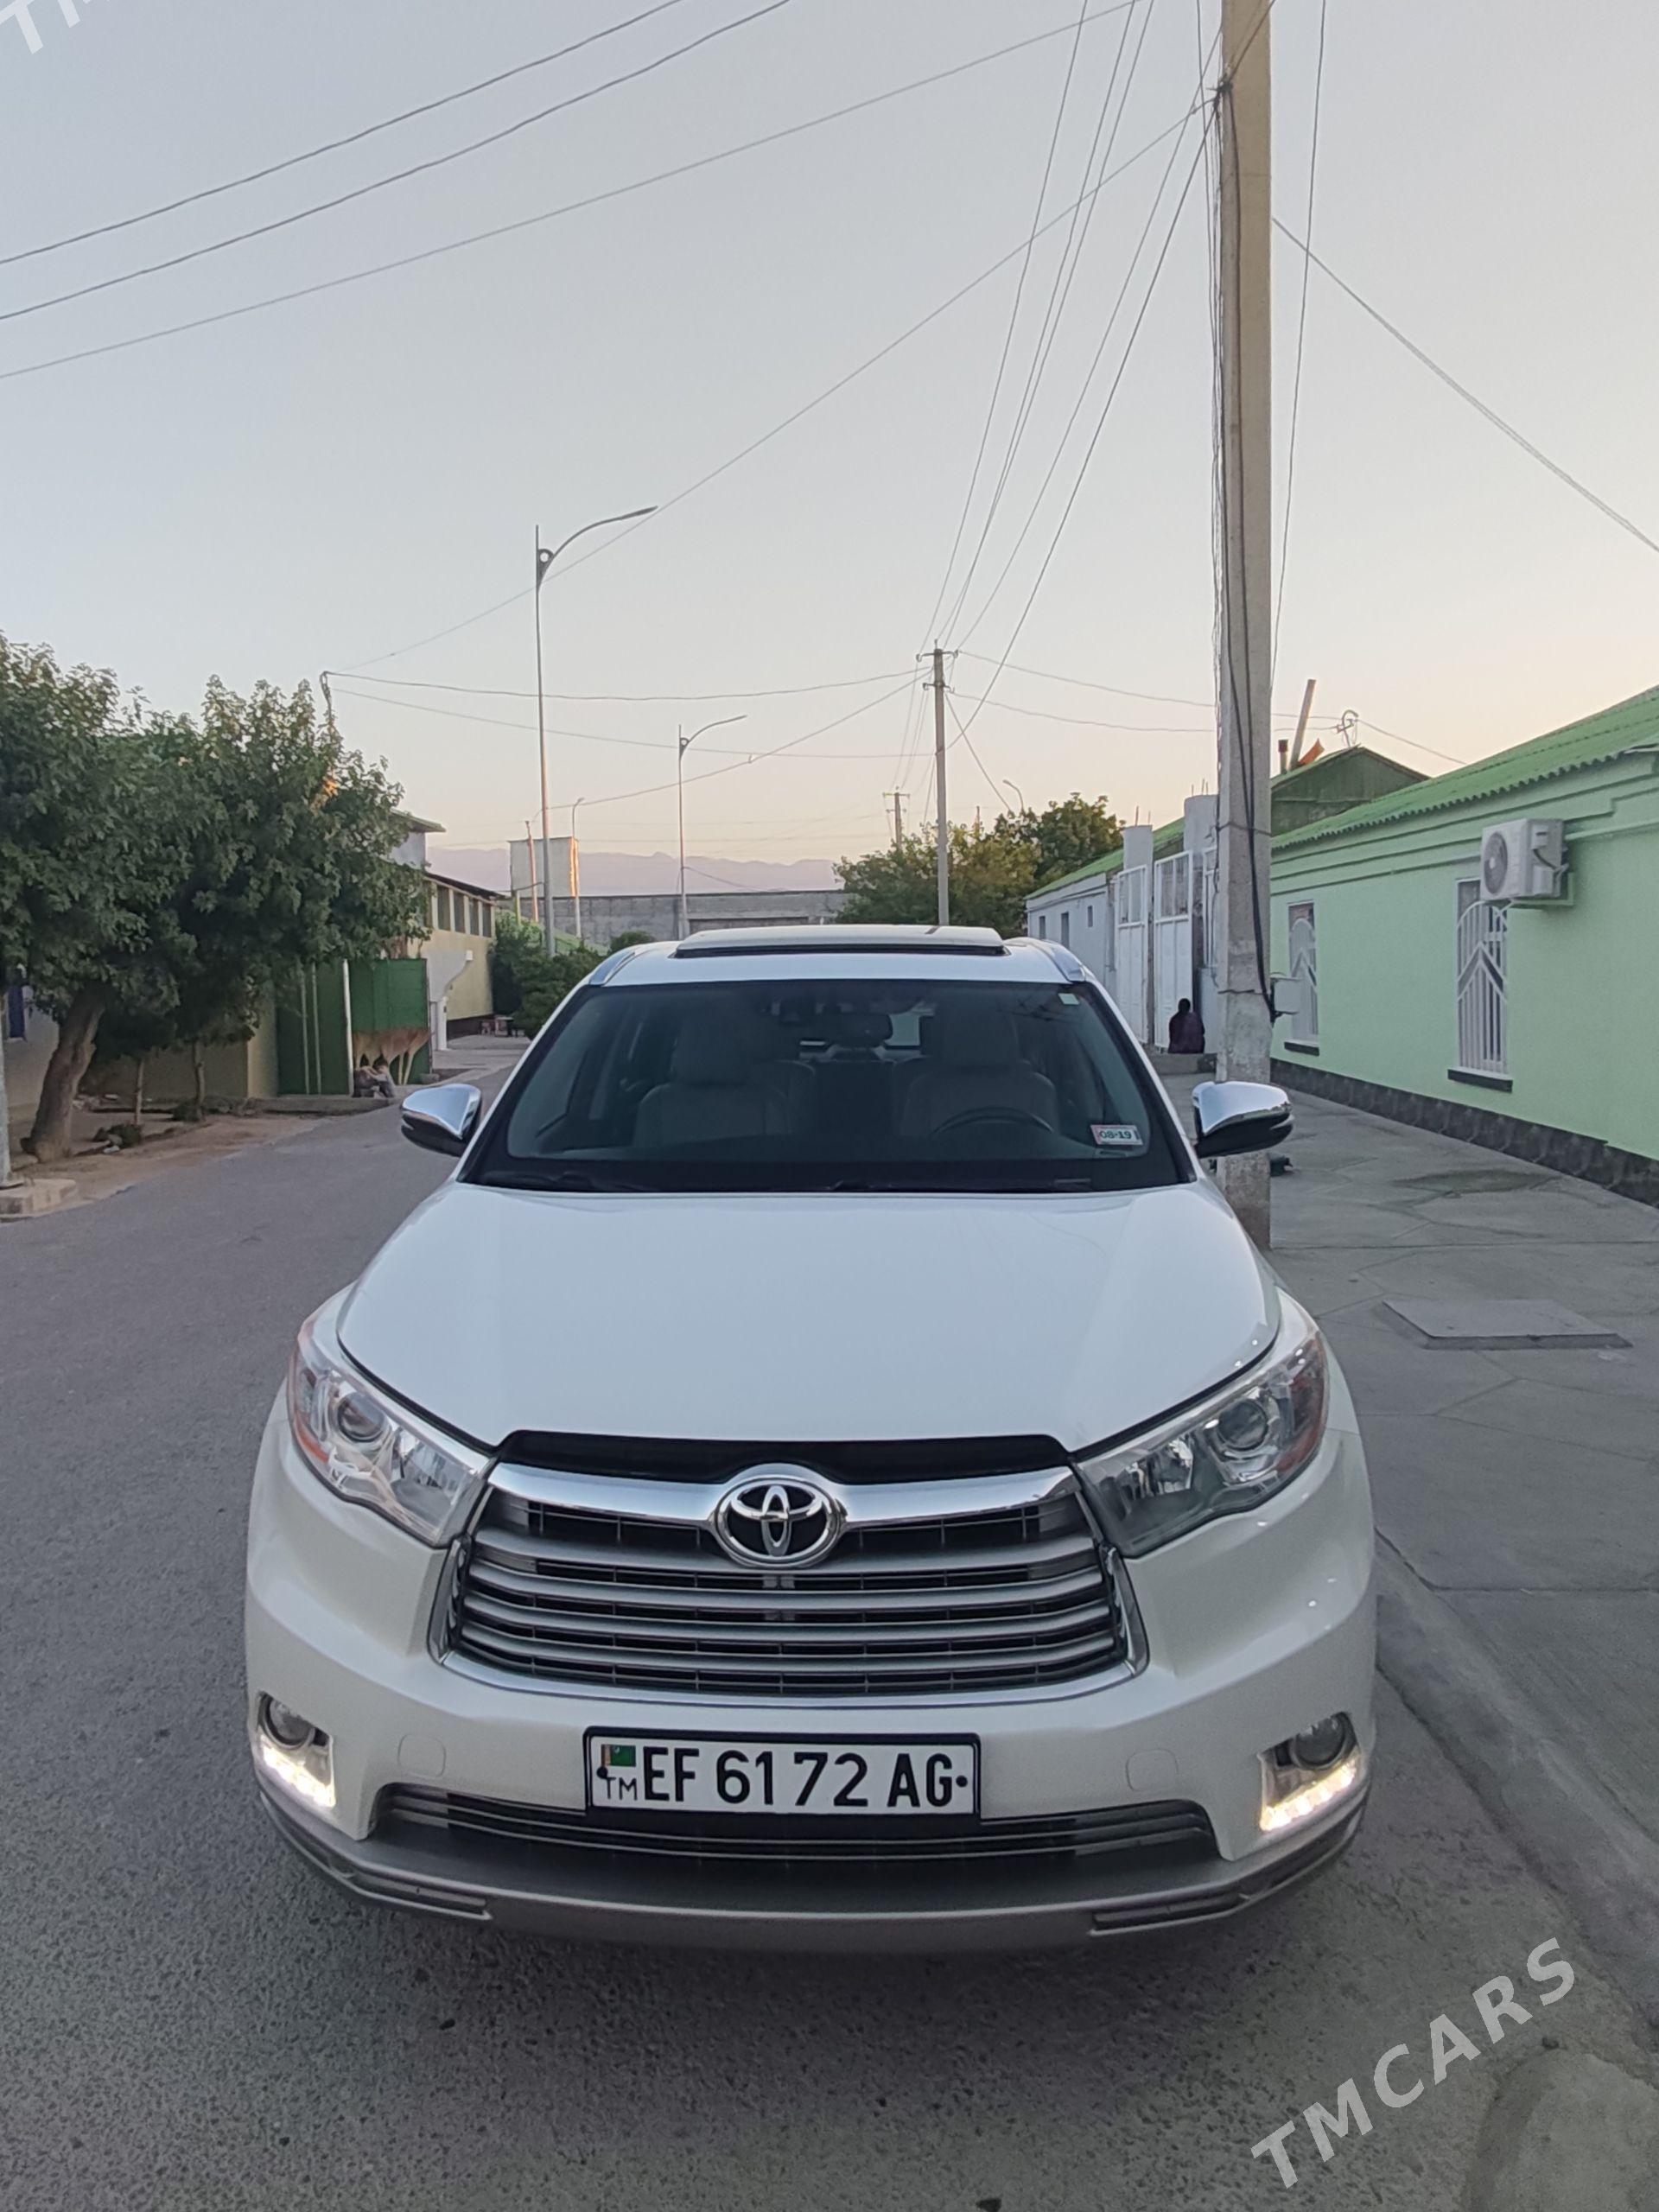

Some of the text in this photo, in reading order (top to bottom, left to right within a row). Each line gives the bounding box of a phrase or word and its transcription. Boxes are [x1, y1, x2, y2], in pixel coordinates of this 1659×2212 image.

[604, 1777, 638, 1801] TM
[643, 1745, 700, 1802] EF
[887, 1753, 952, 1808] AG
